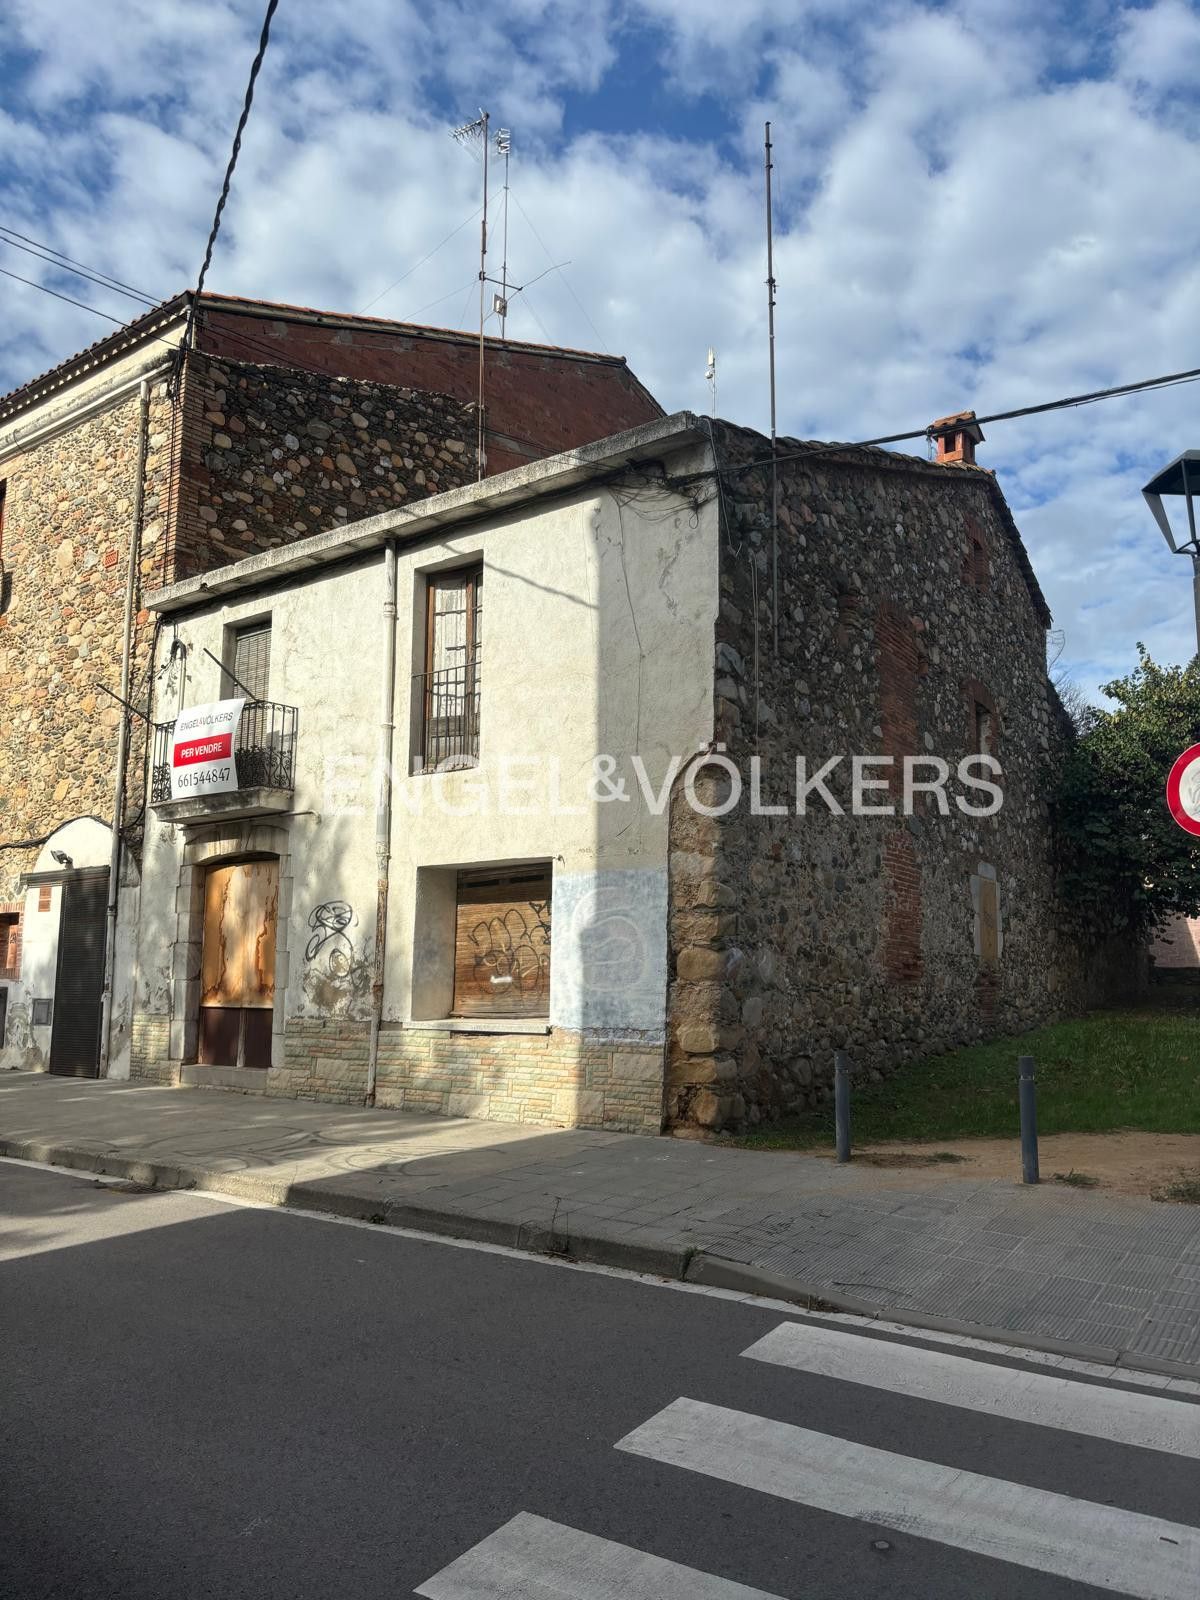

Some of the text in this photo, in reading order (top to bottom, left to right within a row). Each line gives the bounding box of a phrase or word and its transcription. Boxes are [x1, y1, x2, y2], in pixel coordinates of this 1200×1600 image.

[181, 742, 223, 759] PER VENDRE
[178, 768, 230, 788] 661544847
